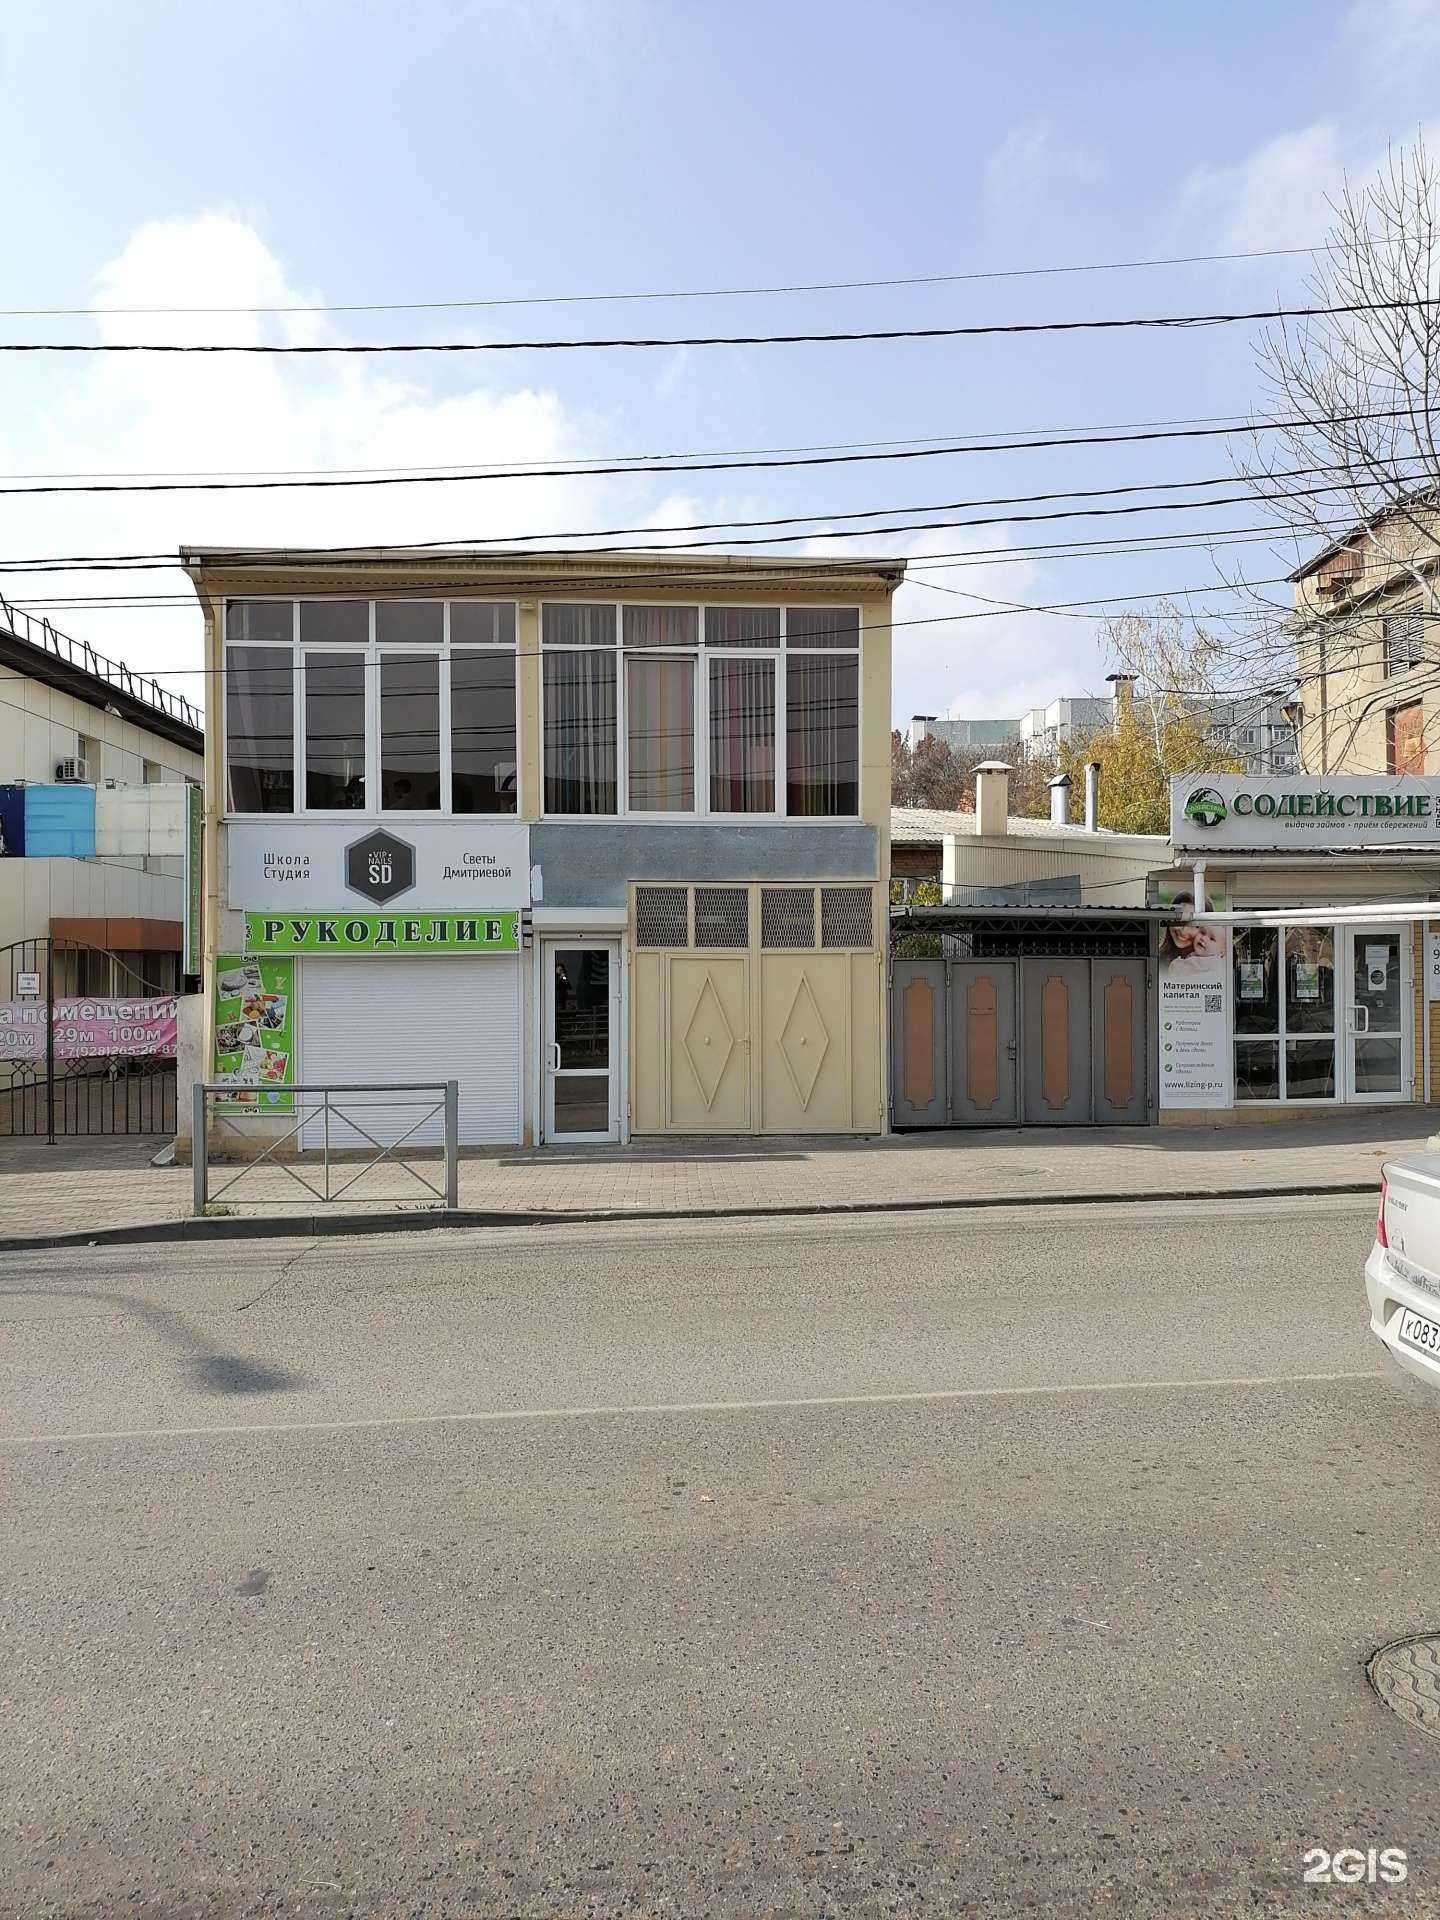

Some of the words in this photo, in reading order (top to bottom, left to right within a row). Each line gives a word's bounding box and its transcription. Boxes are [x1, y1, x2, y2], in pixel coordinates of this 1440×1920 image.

[1233, 790, 1432, 819] СОДЕЙСТВИЕ
[1285, 821, 1314, 830] выдача
[1316, 821, 1345, 829] займов
[1380, 820, 1428, 830] сбережений
[263, 852, 310, 865] Школа
[369, 857, 393, 865] NAILS
[462, 852, 496, 865] Светы
[263, 867, 310, 880] Студия
[369, 864, 392, 884] SD
[443, 865, 512, 880] Дмитриевой
[262, 919, 503, 947] РУКОДЕЛИЕ
[1163, 981, 1223, 991] Материнский
[108, 1026, 161, 1042] 100м
[1164, 1080, 1223, 1089] www.lizing-p.ru
[1405, 1320, 1440, 1351] К083
